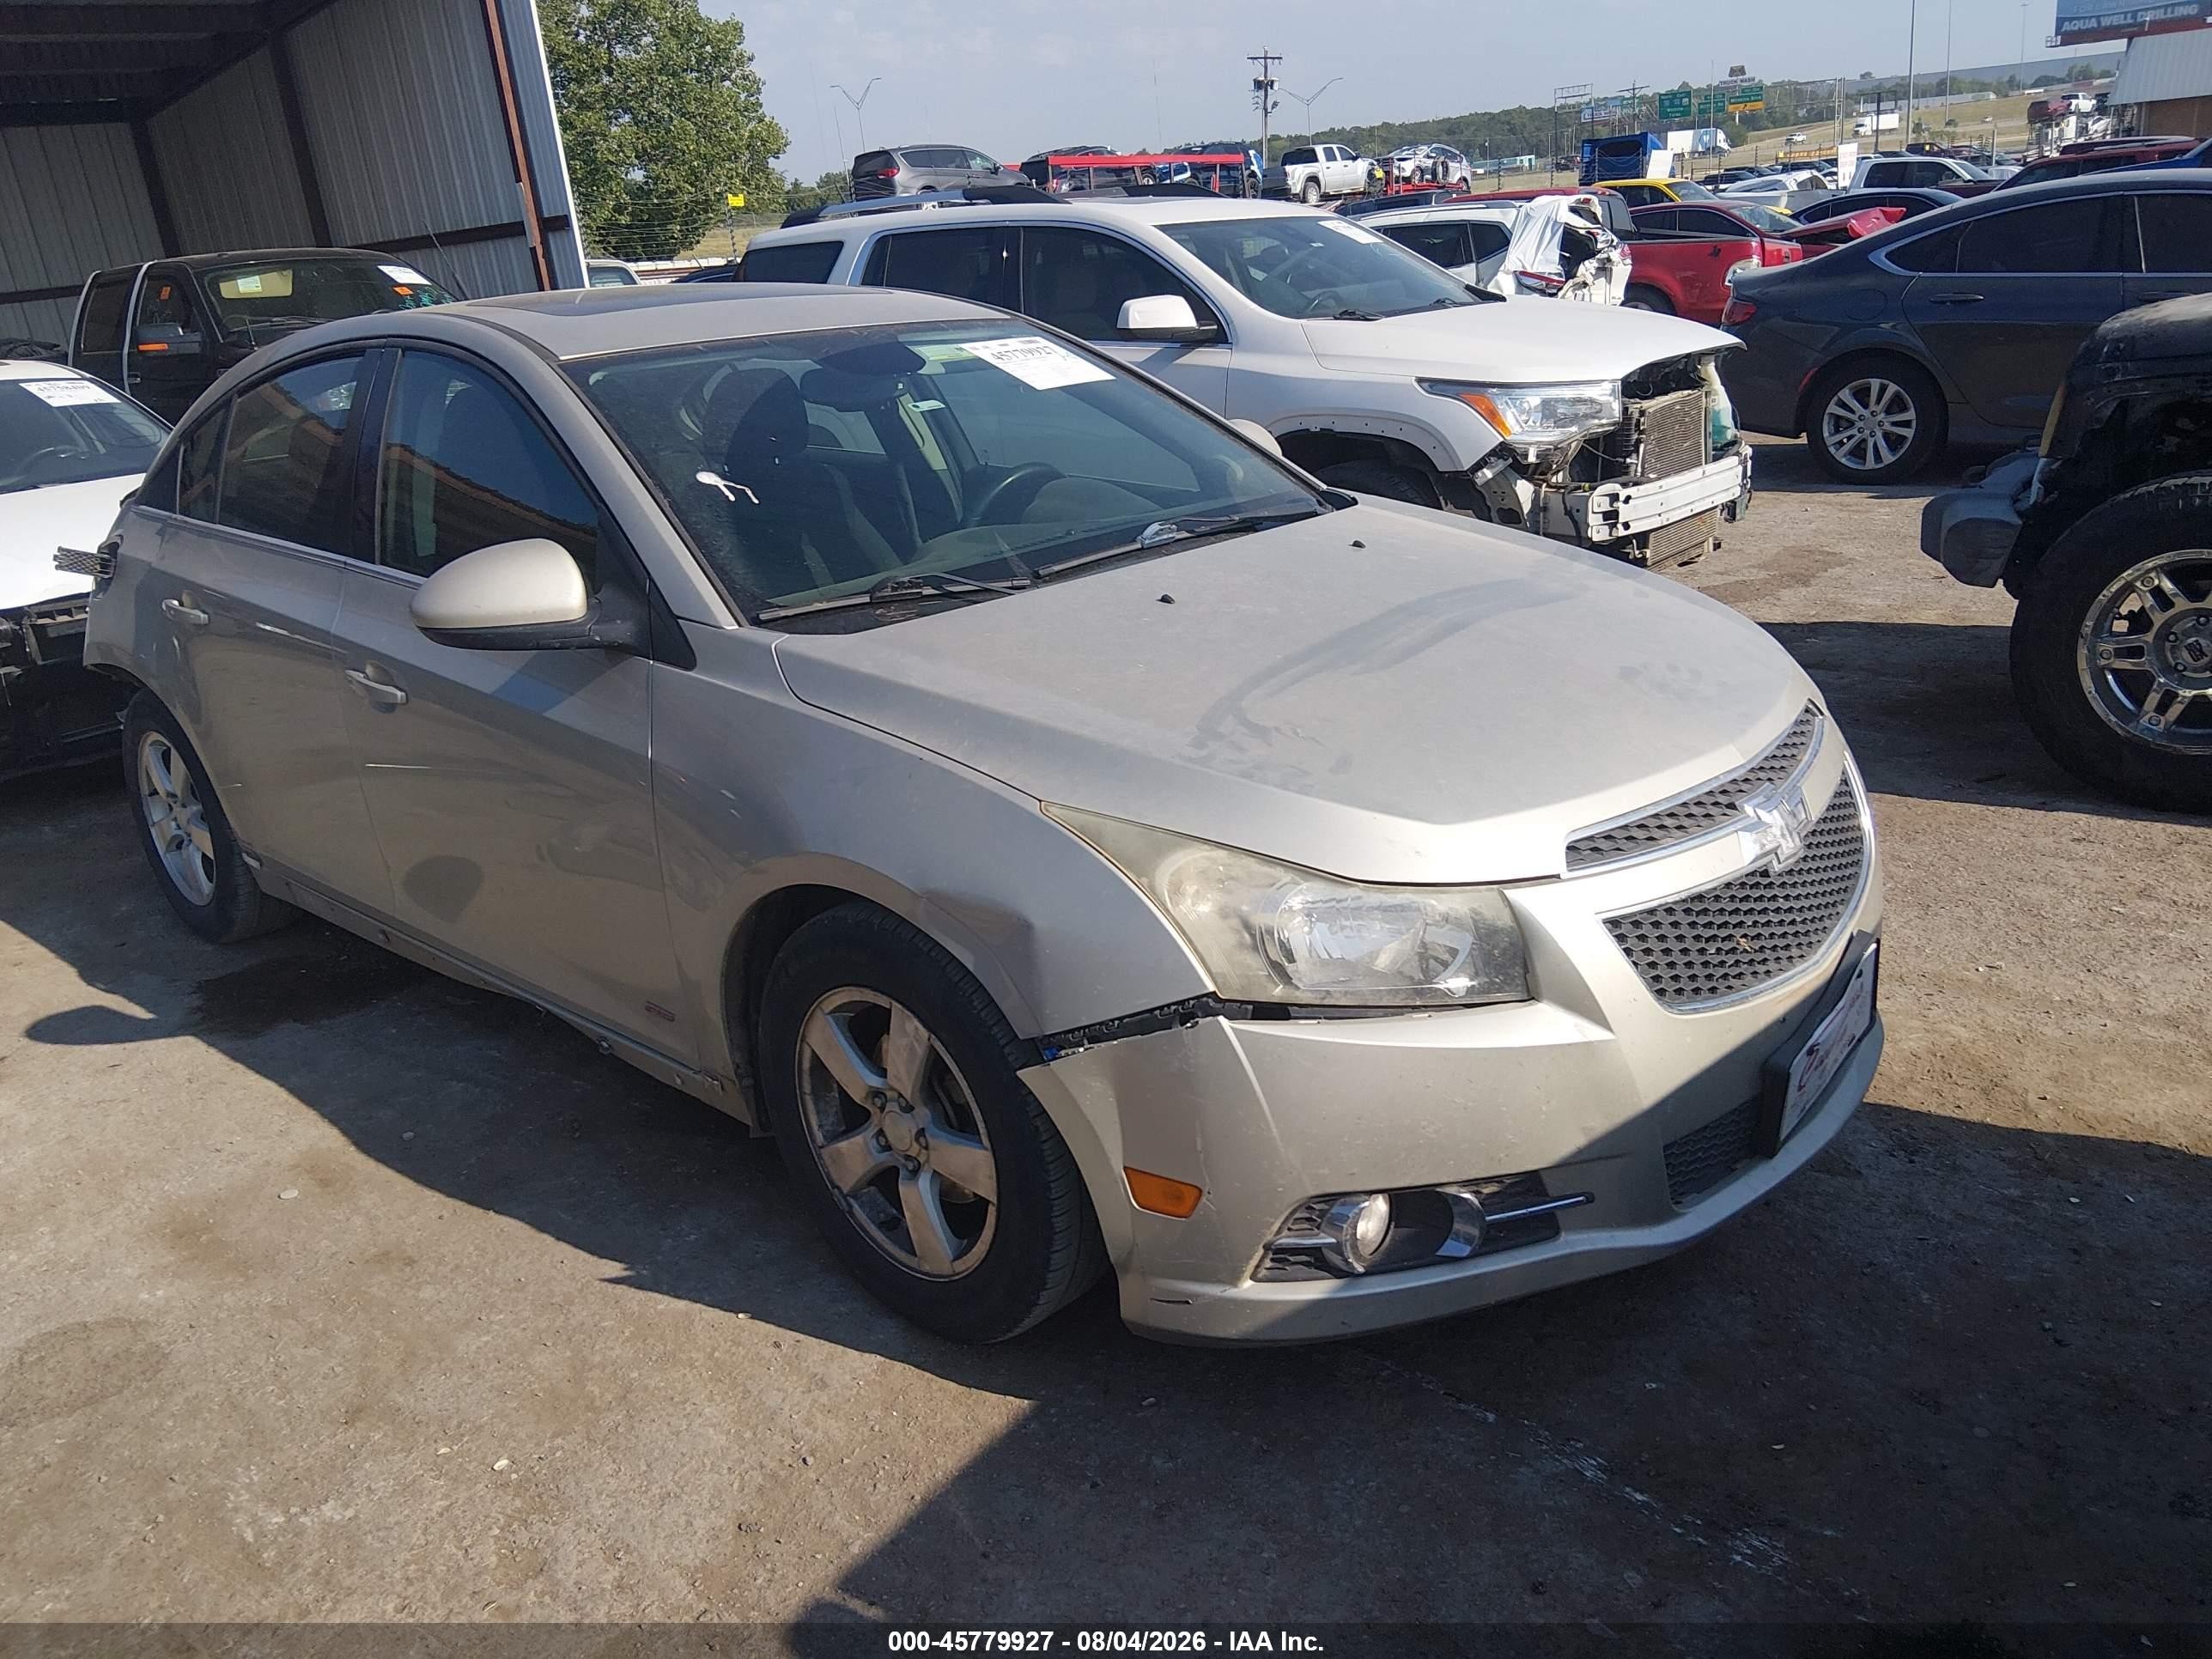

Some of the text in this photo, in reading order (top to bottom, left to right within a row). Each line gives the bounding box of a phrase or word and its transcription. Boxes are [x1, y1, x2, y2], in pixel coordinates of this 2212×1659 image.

[2061, 4, 2199, 32] AQUA WELL DRILLING
[990, 346, 1059, 361] 45779927
